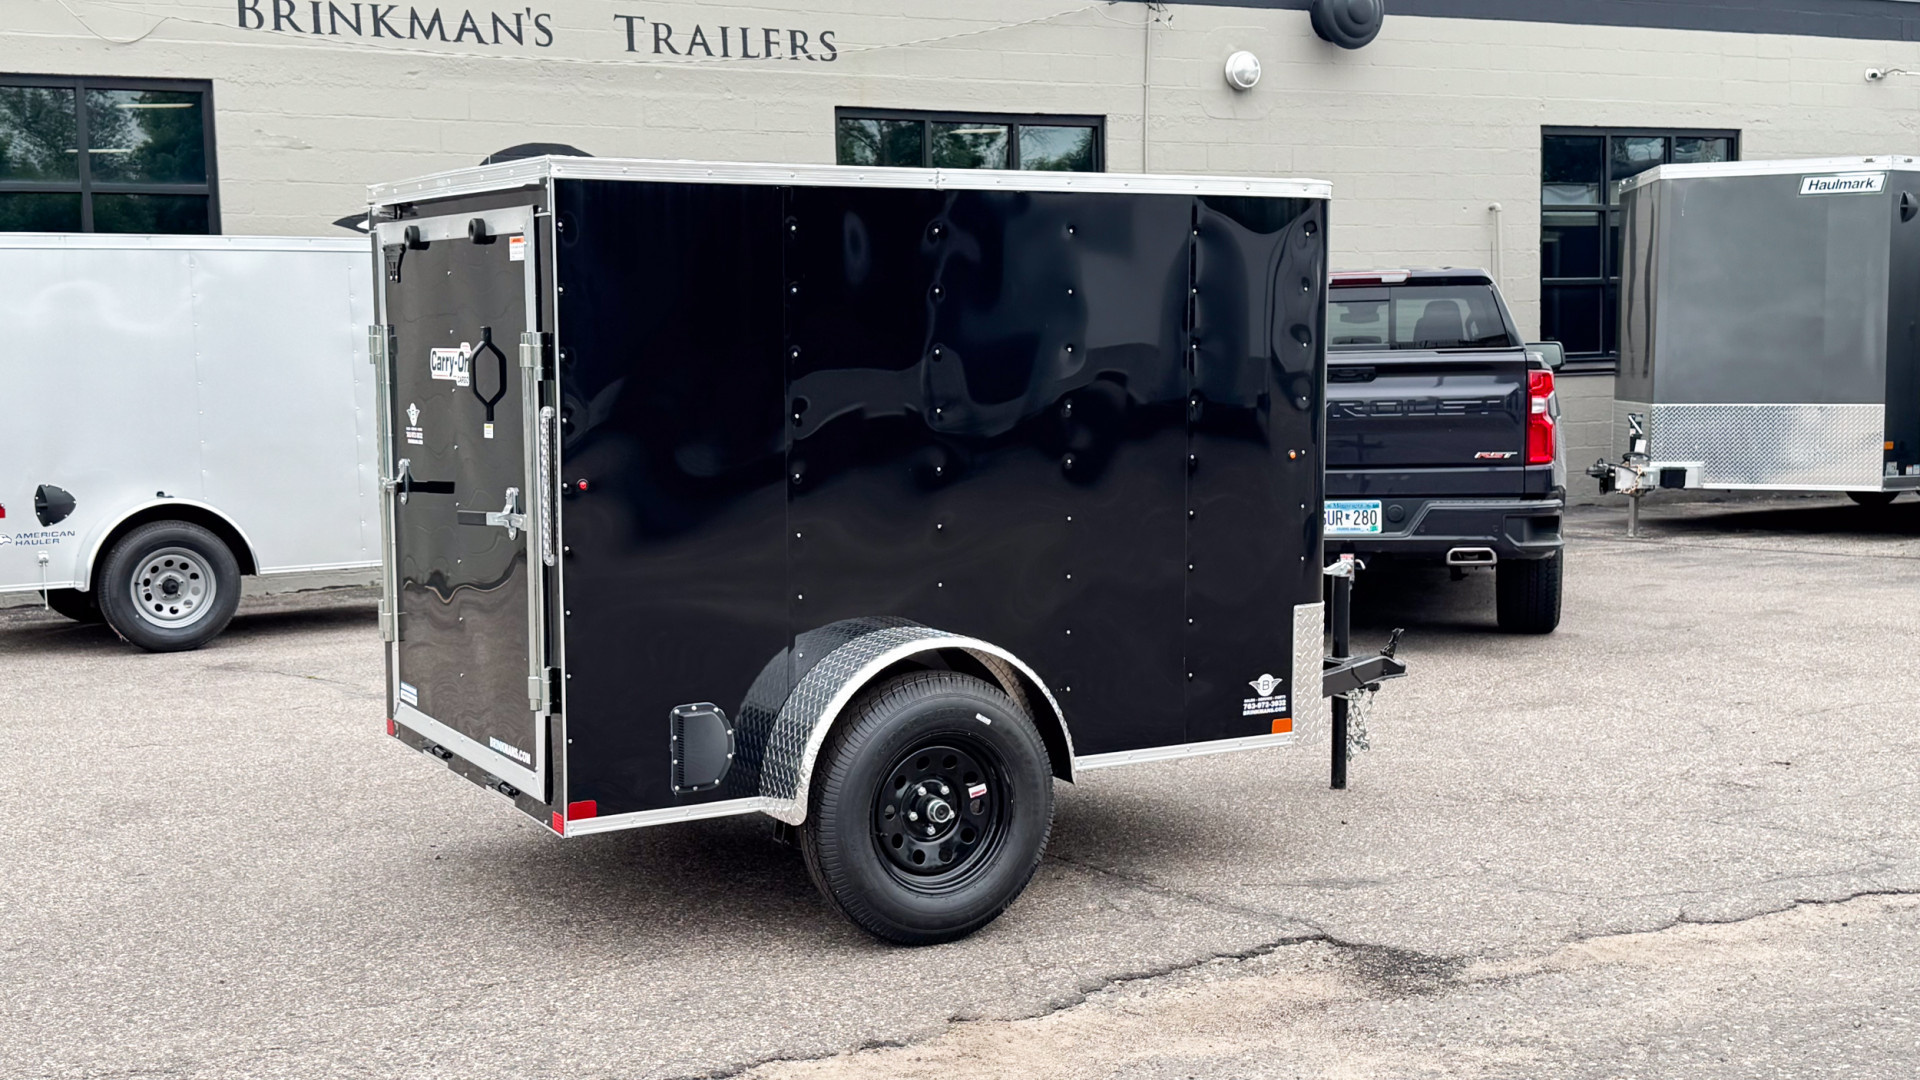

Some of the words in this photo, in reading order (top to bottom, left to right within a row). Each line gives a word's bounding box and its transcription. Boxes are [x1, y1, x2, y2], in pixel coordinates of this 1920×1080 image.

[238, 0, 554, 47] BRINKMAN'S
[613, 14, 838, 62] TRAILERS
[1807, 177, 1875, 191] Haulmark
[1474, 451, 1518, 459] RST
[1353, 509, 1378, 526] 280
[15, 530, 76, 539] AMERICAN
[15, 538, 60, 546] HAULER
